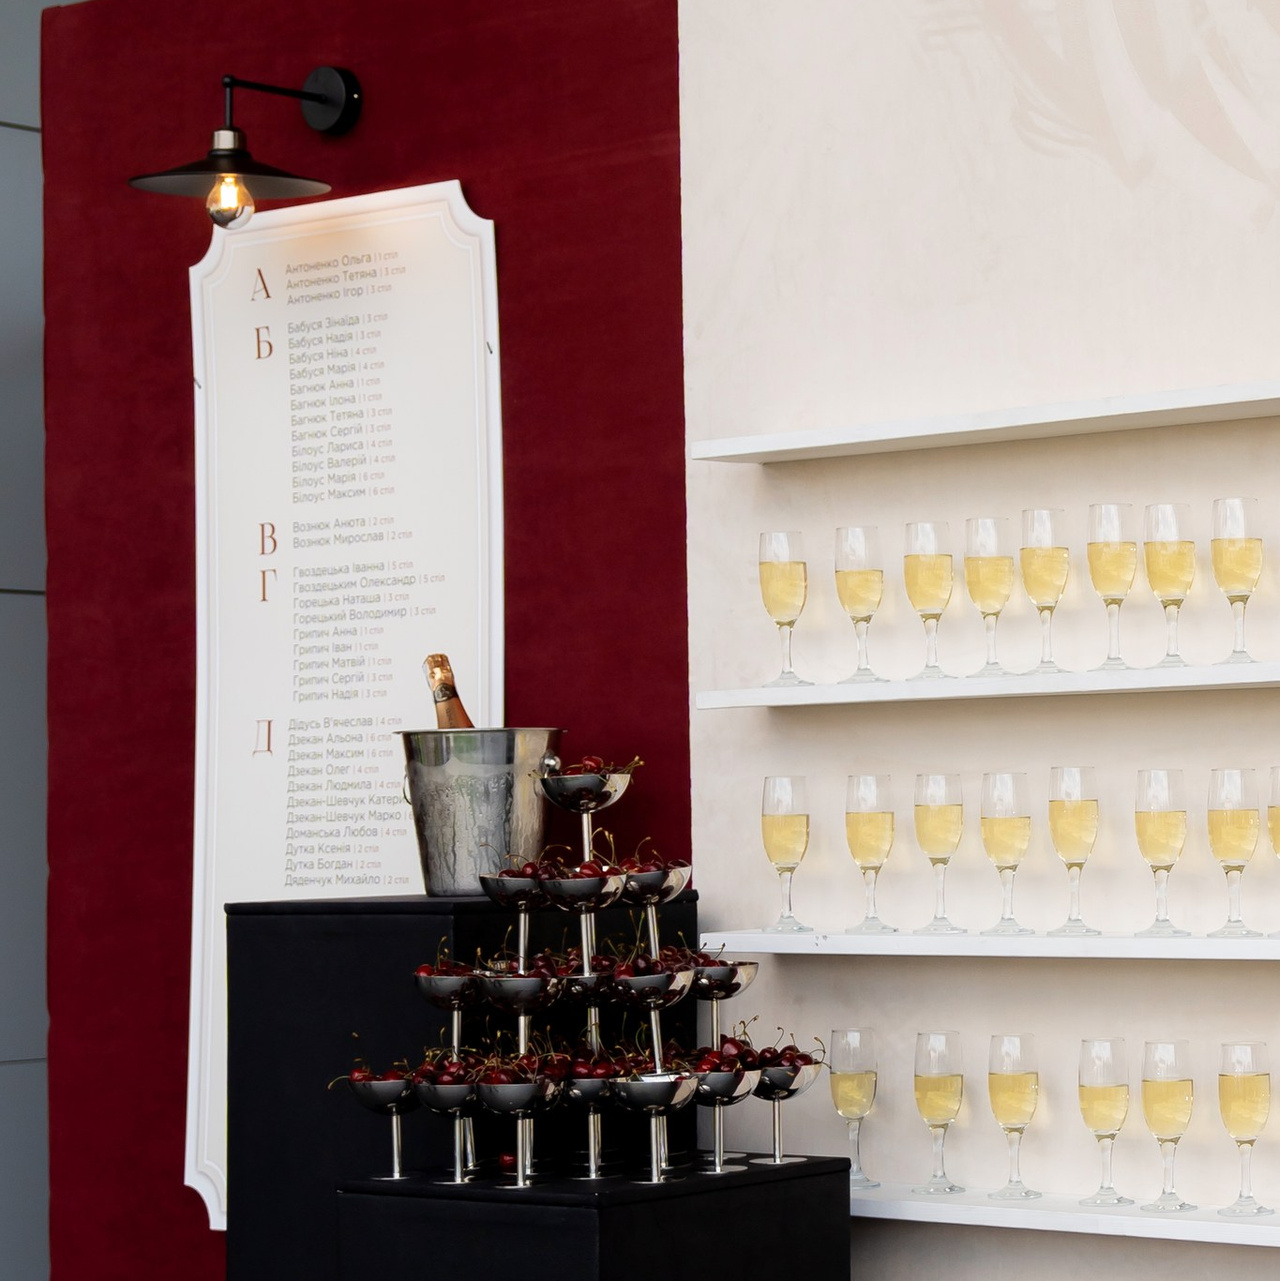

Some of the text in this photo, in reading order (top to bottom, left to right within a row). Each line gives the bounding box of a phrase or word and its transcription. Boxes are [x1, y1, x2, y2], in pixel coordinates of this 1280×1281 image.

[341, 254, 372, 267] Ольга
[342, 269, 377, 282] Тетяна
[251, 268, 271, 300] А
[343, 286, 364, 297] Ігор
[255, 326, 274, 360] Б
[325, 332, 353, 344] Надія
[327, 362, 356, 375] Марія
[329, 379, 354, 391] Анна
[330, 409, 364, 421] Тетяна
[327, 441, 364, 454] Лариса
[328, 488, 366, 499] Максим
[259, 522, 277, 555] В
[333, 532, 384, 545] Мирослав
[260, 569, 277, 601] Г
[342, 594, 381, 605] Наташа
[253, 720, 273, 757] Д
